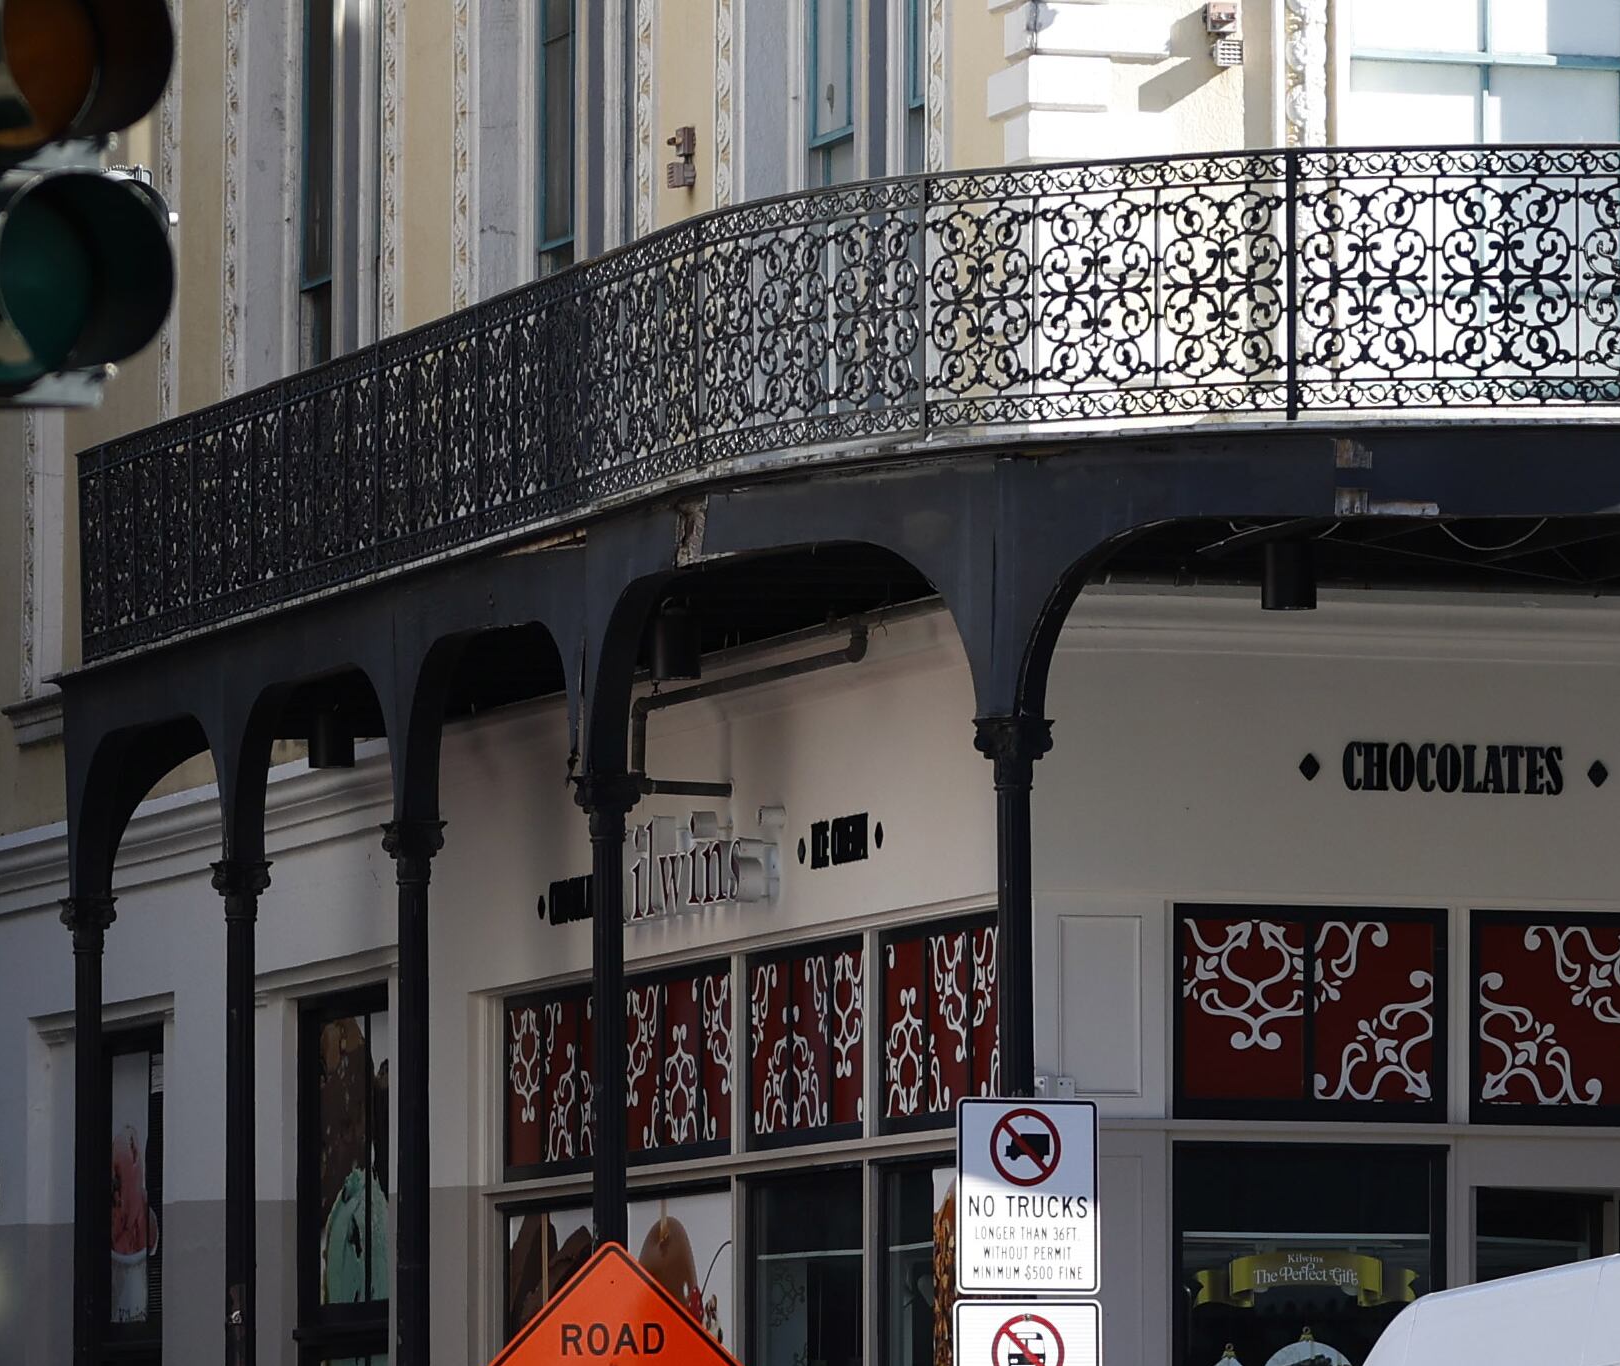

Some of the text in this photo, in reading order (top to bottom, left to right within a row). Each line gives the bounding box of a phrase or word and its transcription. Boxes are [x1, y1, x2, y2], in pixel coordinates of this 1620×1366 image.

[1341, 740, 1565, 797] CHOCOLATES
[631, 811, 743, 922] ilwins
[968, 1195, 1089, 1219] NO TRUCKS
[974, 1226, 1018, 1241] LONGER
[1020, 1226, 1049, 1241] THAN
[983, 1245, 1072, 1260] WITHOUT PERMIT
[1287, 1253, 1324, 1263] Kilwins
[972, 1265, 1084, 1281] MINIMUM $500 FINE
[1253, 1269, 1278, 1284] The
[1279, 1263, 1328, 1281] Perfect
[561, 1323, 666, 1356] ROAD
